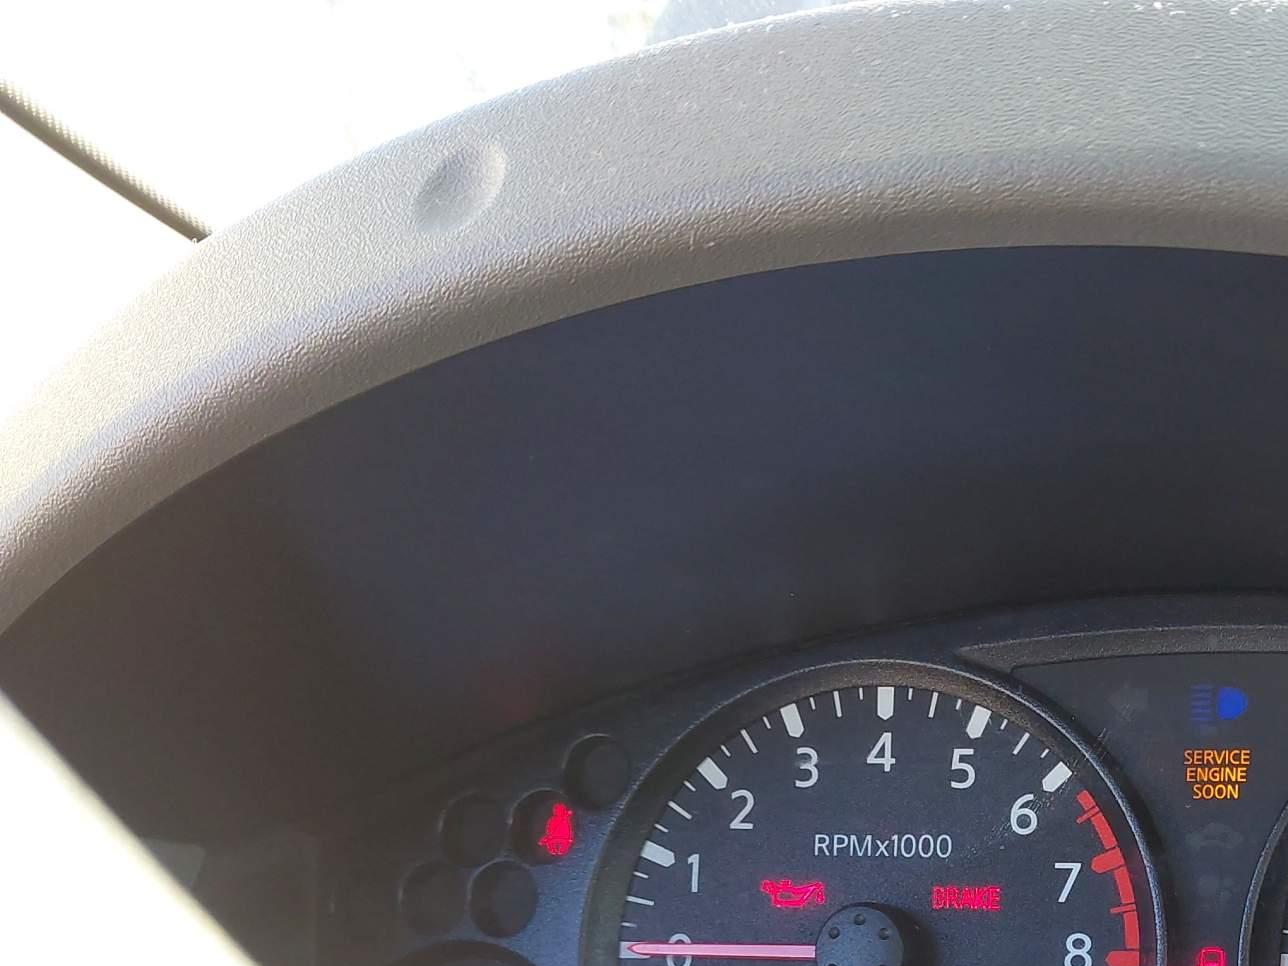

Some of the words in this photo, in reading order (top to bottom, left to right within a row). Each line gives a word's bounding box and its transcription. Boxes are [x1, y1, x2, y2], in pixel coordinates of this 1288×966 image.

[794, 748, 819, 788] 3
[866, 732, 896, 772] 4
[950, 749, 976, 790] 5
[1184, 750, 1251, 765] SERVICE
[1186, 768, 1247, 782] ENGINE
[1193, 784, 1239, 799] SOON
[730, 790, 754, 830] 2
[1010, 794, 1036, 835] 6
[814, 834, 952, 858] RPMx1000
[688, 854, 700, 892] 1
[1054, 863, 1082, 902] 7
[932, 887, 1001, 910] BRAKE
